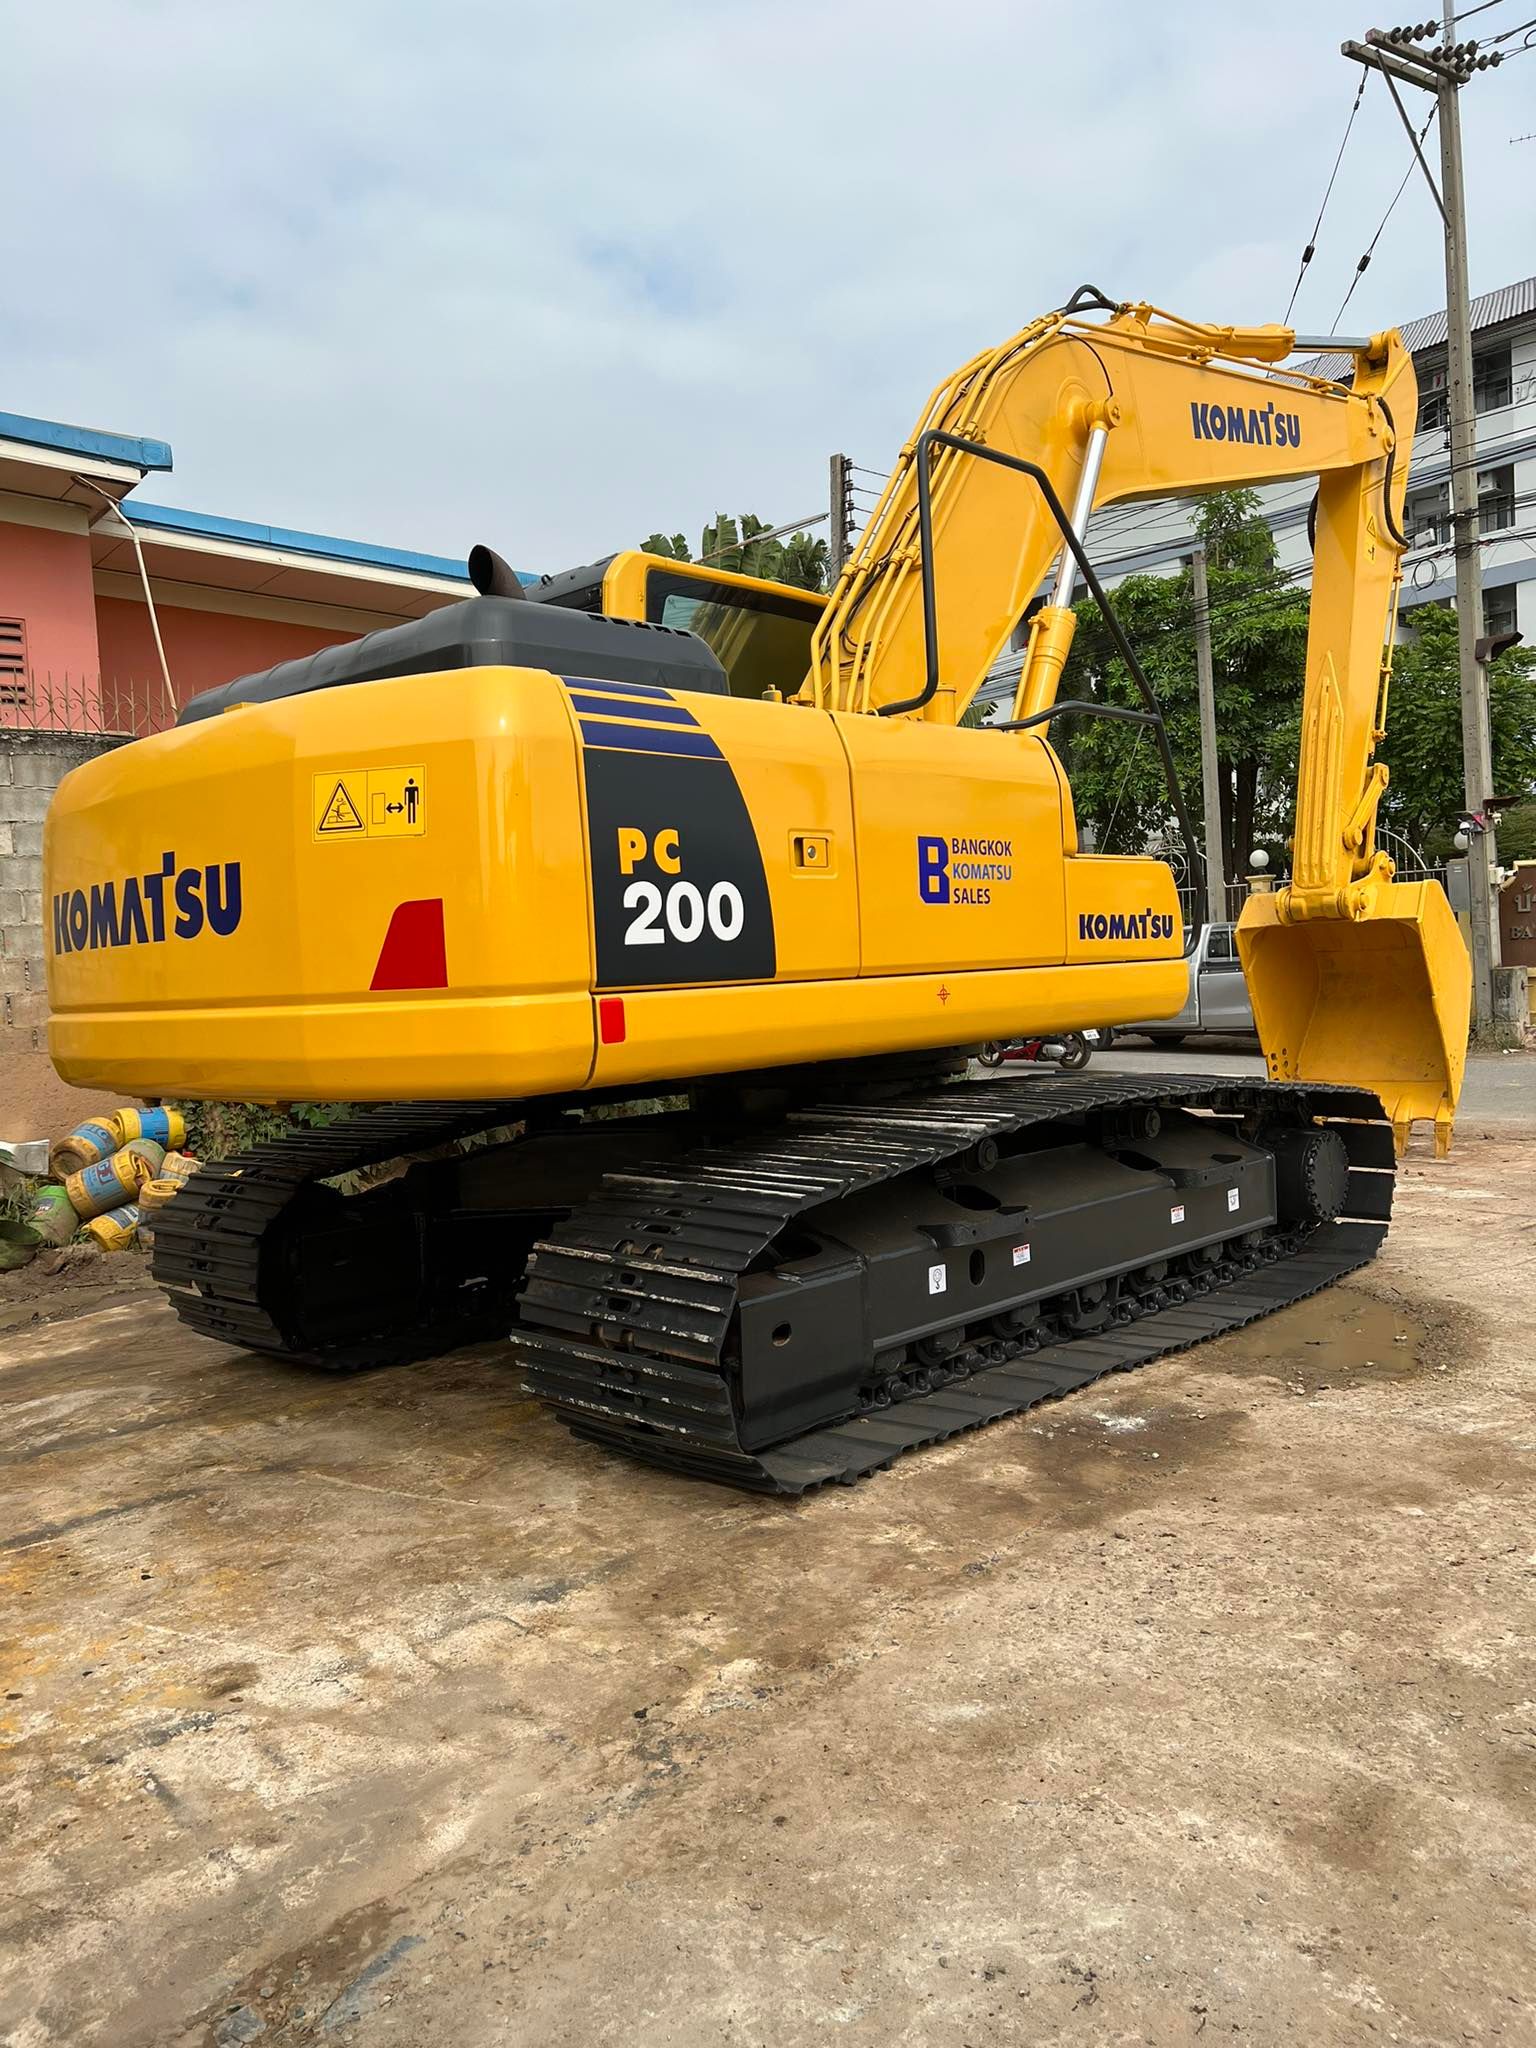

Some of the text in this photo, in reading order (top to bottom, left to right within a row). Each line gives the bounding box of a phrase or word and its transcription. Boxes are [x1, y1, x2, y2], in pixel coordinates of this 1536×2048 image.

[1191, 401, 1301, 448] KOMATSU
[617, 827, 682, 875] PC
[951, 838, 1012, 857] BANGKOK
[952, 863, 1012, 881] KOMATSU
[54, 851, 242, 956] KOMATSU
[623, 880, 745, 946] 200
[953, 887, 991, 905] SALES
[1079, 907, 1174, 940] KOMATSU
